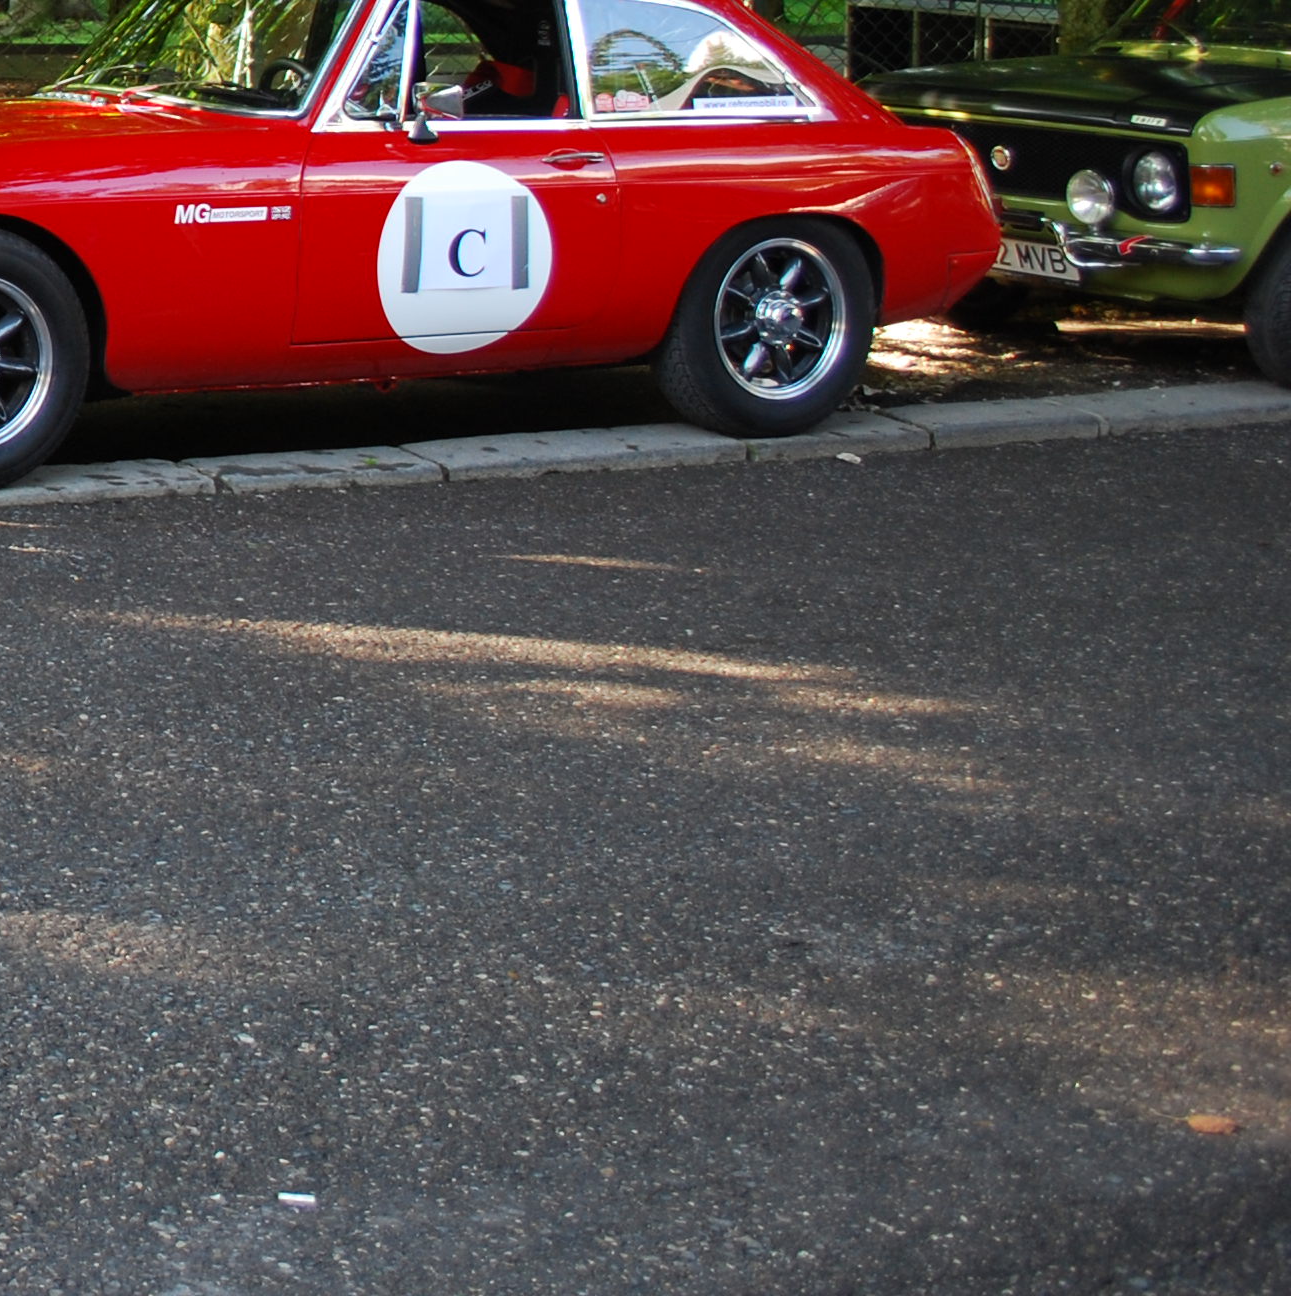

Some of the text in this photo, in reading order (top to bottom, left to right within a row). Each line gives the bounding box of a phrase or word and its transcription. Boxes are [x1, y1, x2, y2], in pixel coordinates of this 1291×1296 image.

[174, 203, 265, 224] MG MOTORSPORT
[448, 228, 487, 277] C
[995, 241, 1066, 274] 2 MVB
